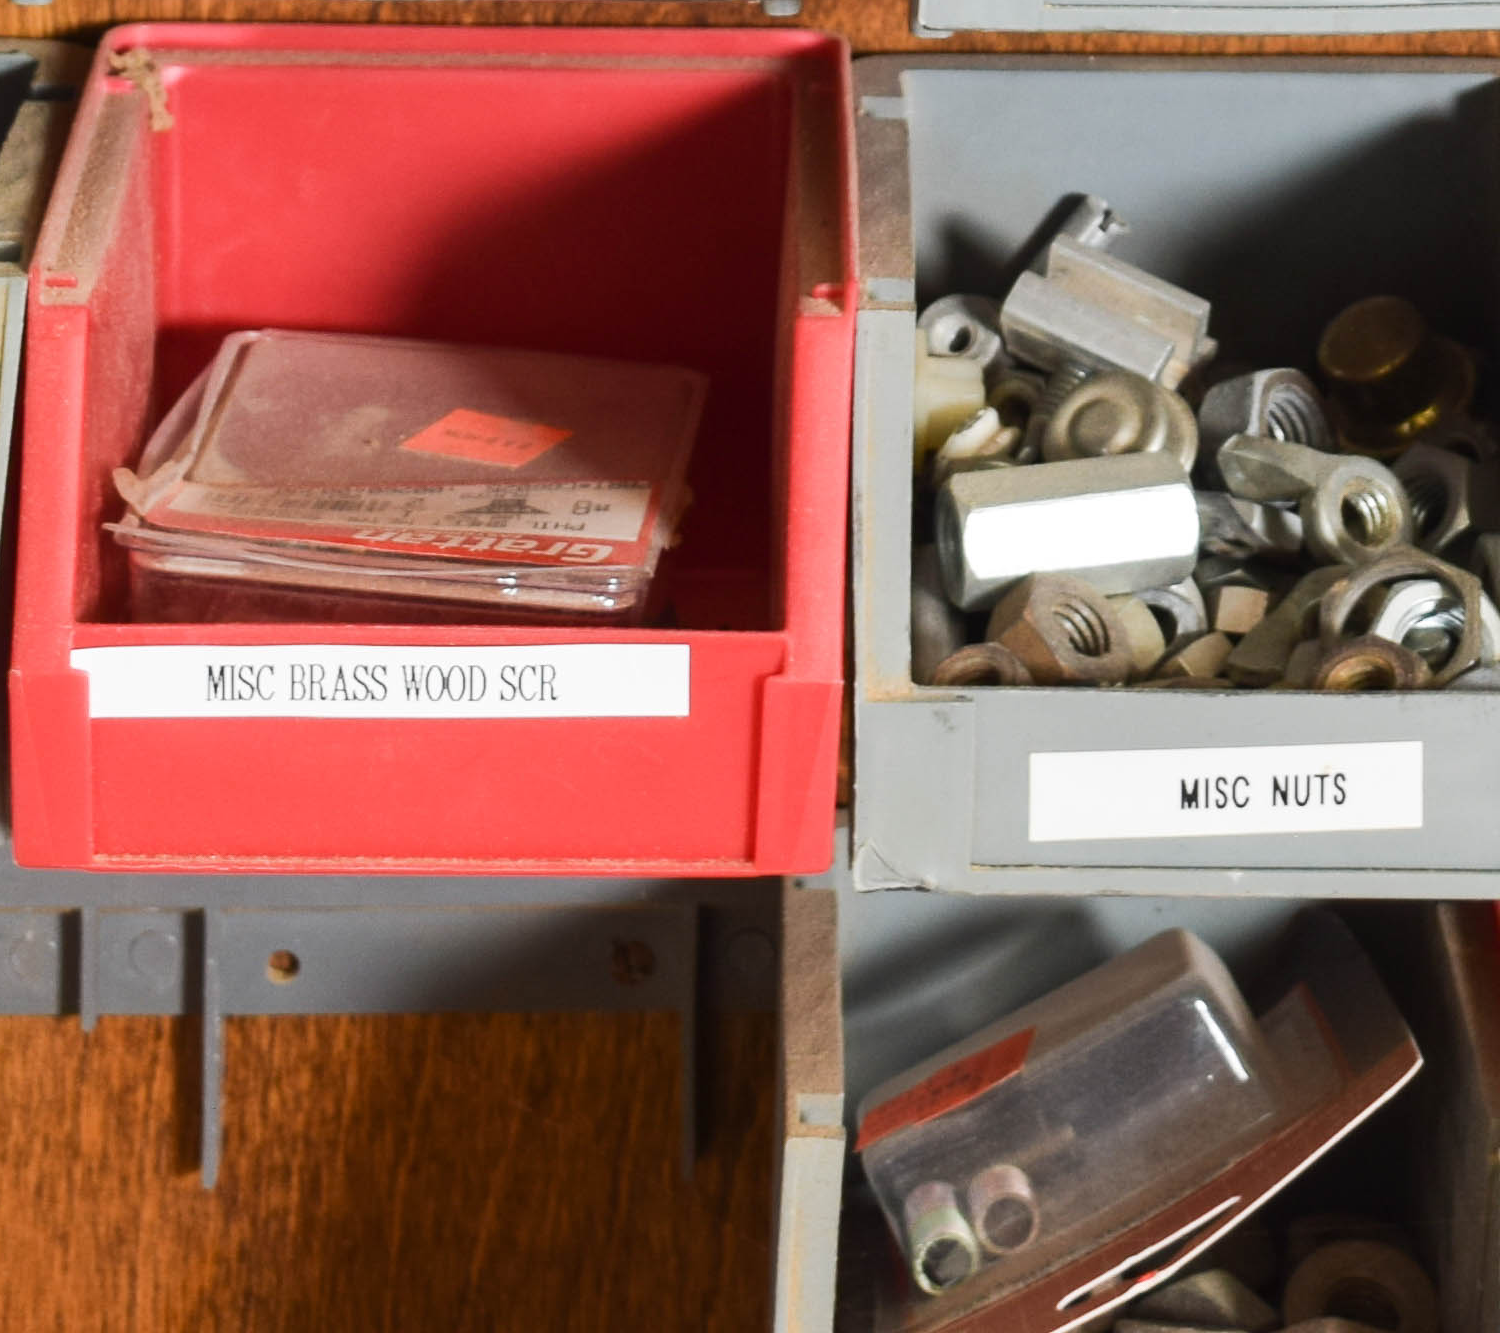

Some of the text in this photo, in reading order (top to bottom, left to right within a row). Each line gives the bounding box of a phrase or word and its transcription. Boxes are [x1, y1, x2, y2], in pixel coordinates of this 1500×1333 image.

[207, 663, 558, 702] MISC BRASS WOOD SCR
[1180, 772, 1347, 810] MISC NUTS
